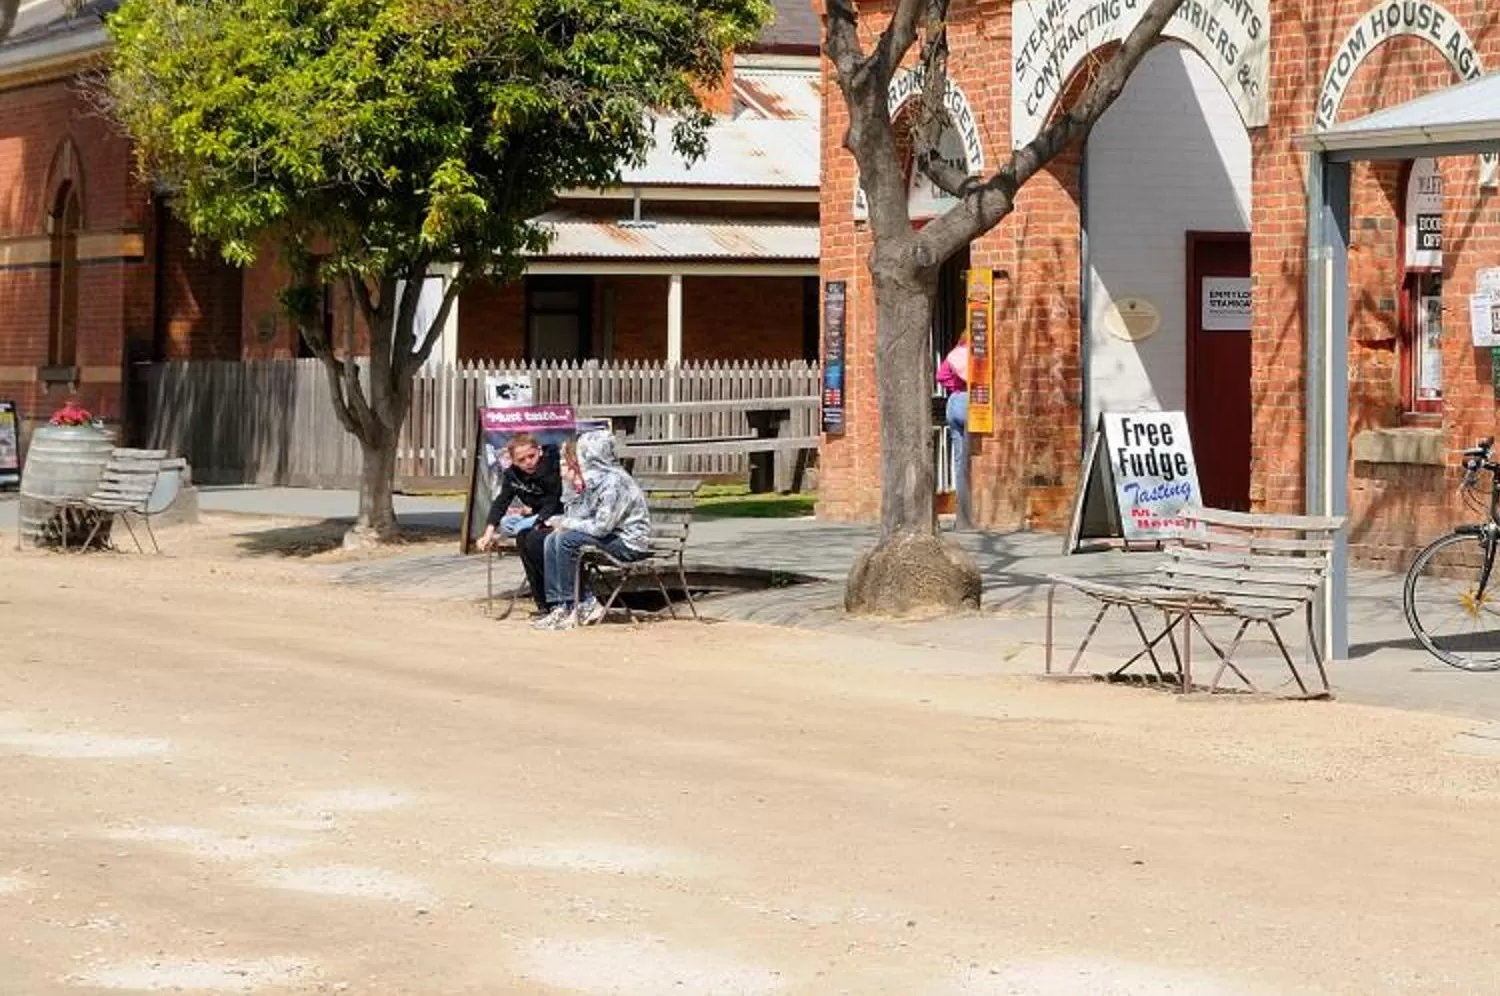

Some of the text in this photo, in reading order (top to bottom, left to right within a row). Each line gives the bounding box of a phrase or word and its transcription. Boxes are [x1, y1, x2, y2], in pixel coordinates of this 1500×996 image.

[1371, 1, 1445, 40] HOUSE
[1121, 417, 1174, 446] Free
[1118, 447, 1188, 481] Fudge
[1124, 482, 1191, 504] Tasting
